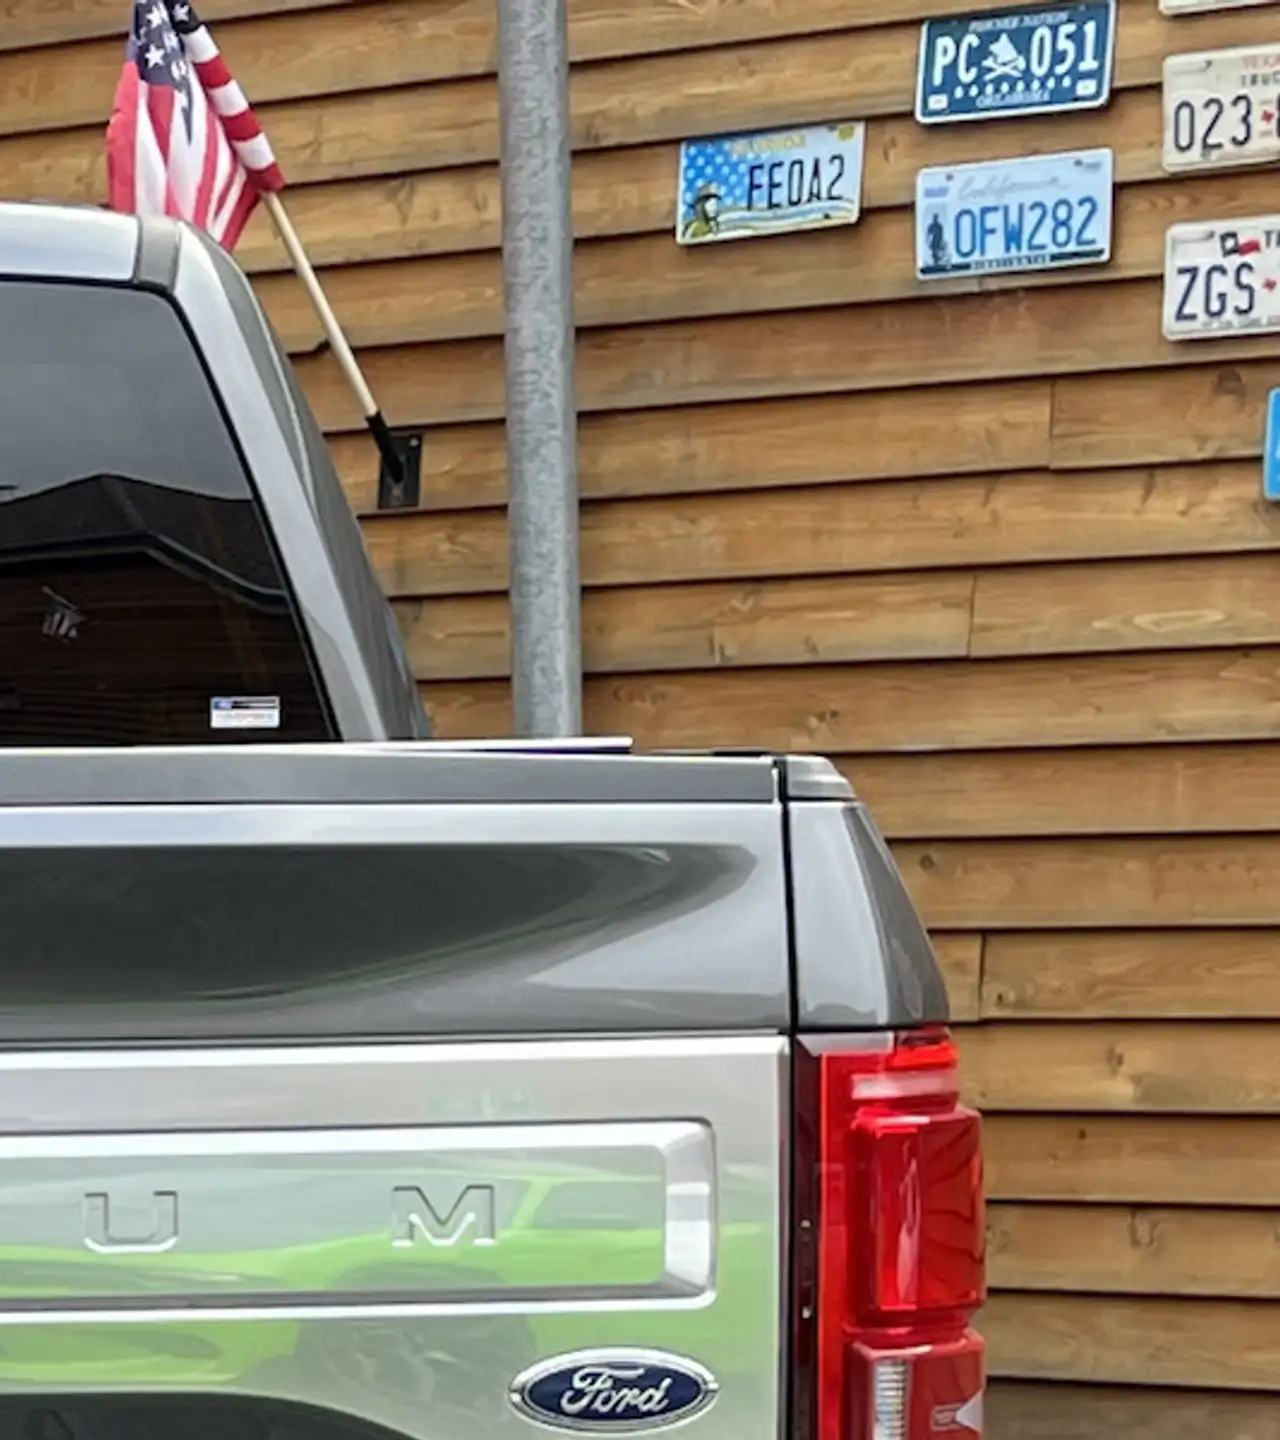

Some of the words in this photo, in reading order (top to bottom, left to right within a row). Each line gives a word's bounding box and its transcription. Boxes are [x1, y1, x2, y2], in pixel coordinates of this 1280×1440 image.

[932, 33, 981, 87] PC
[1030, 20, 1099, 77] 051
[1174, 93, 1252, 152] 023
[1174, 261, 1256, 323] ZGS
[560, 1366, 673, 1414] Ford
